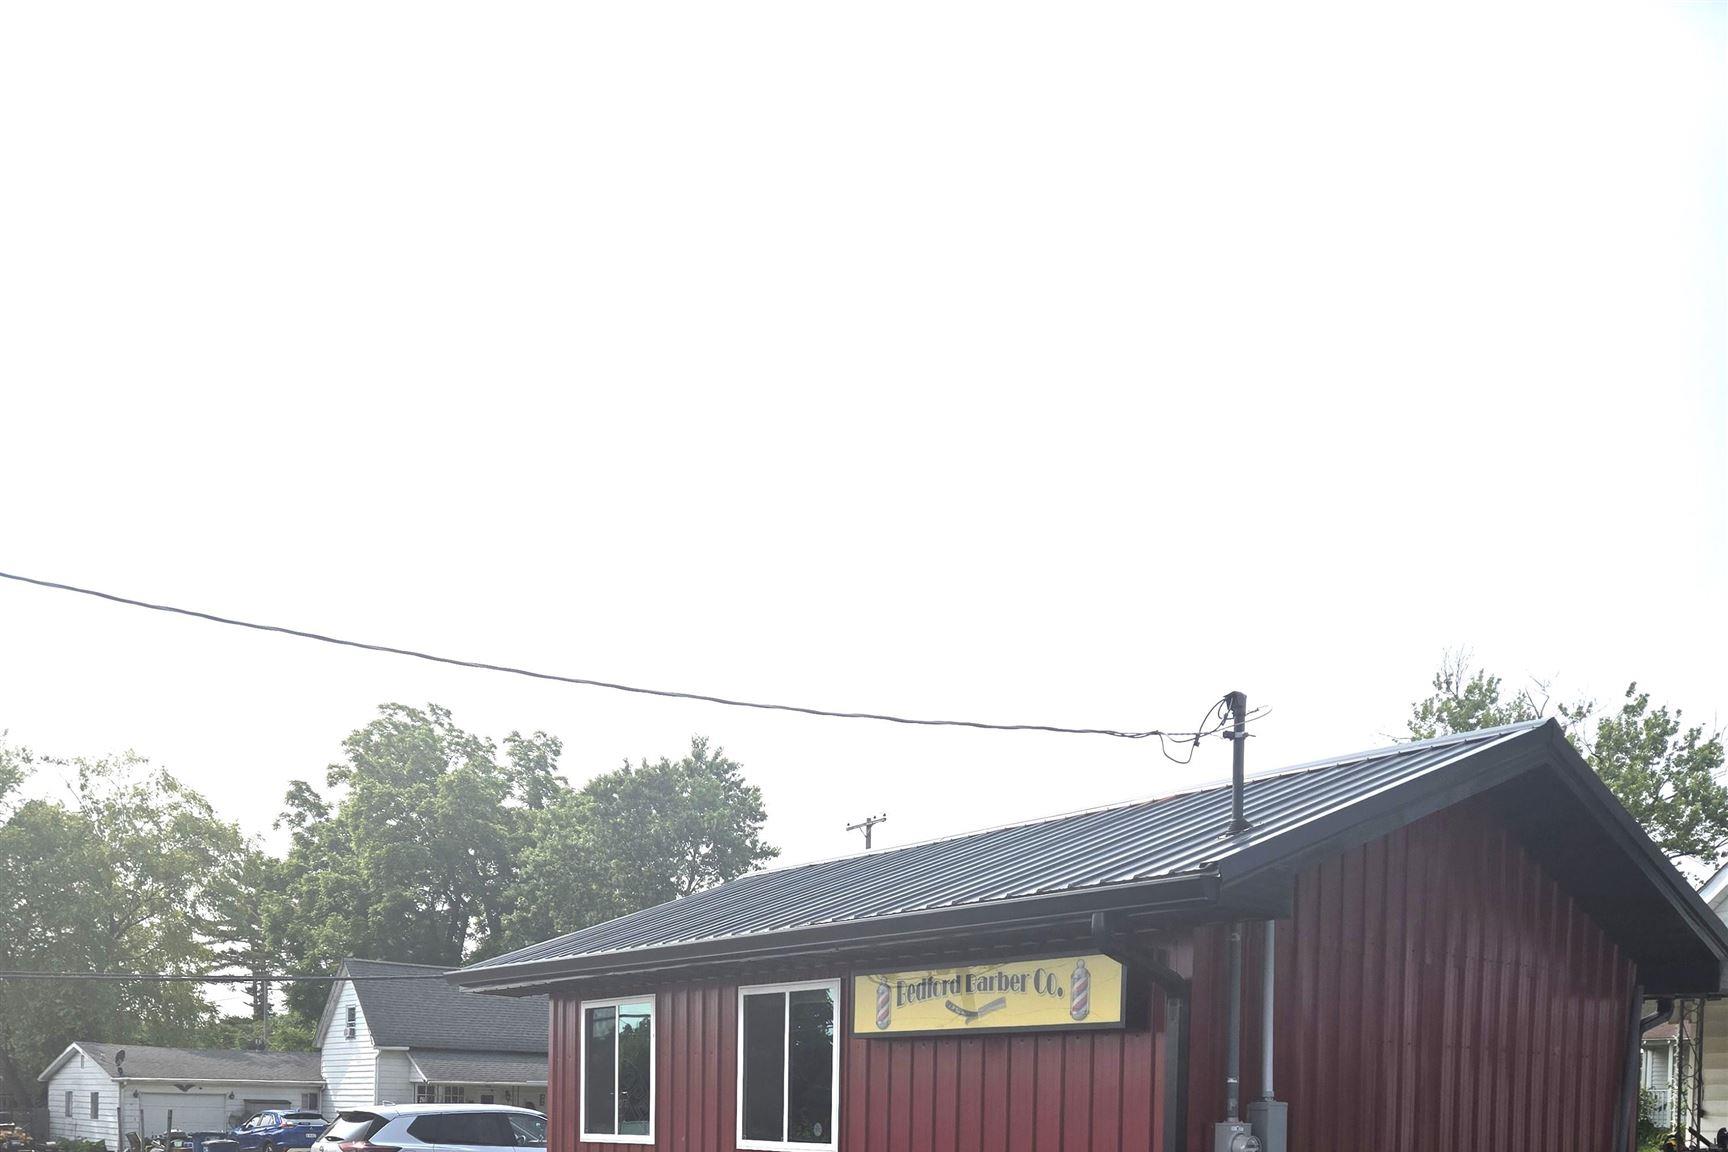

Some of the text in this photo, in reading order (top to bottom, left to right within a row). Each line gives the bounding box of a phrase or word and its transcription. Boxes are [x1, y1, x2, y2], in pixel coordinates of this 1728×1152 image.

[896, 974, 962, 1008] Bedford
[965, 971, 1030, 994] Barber
[1033, 967, 1064, 998] Co.
